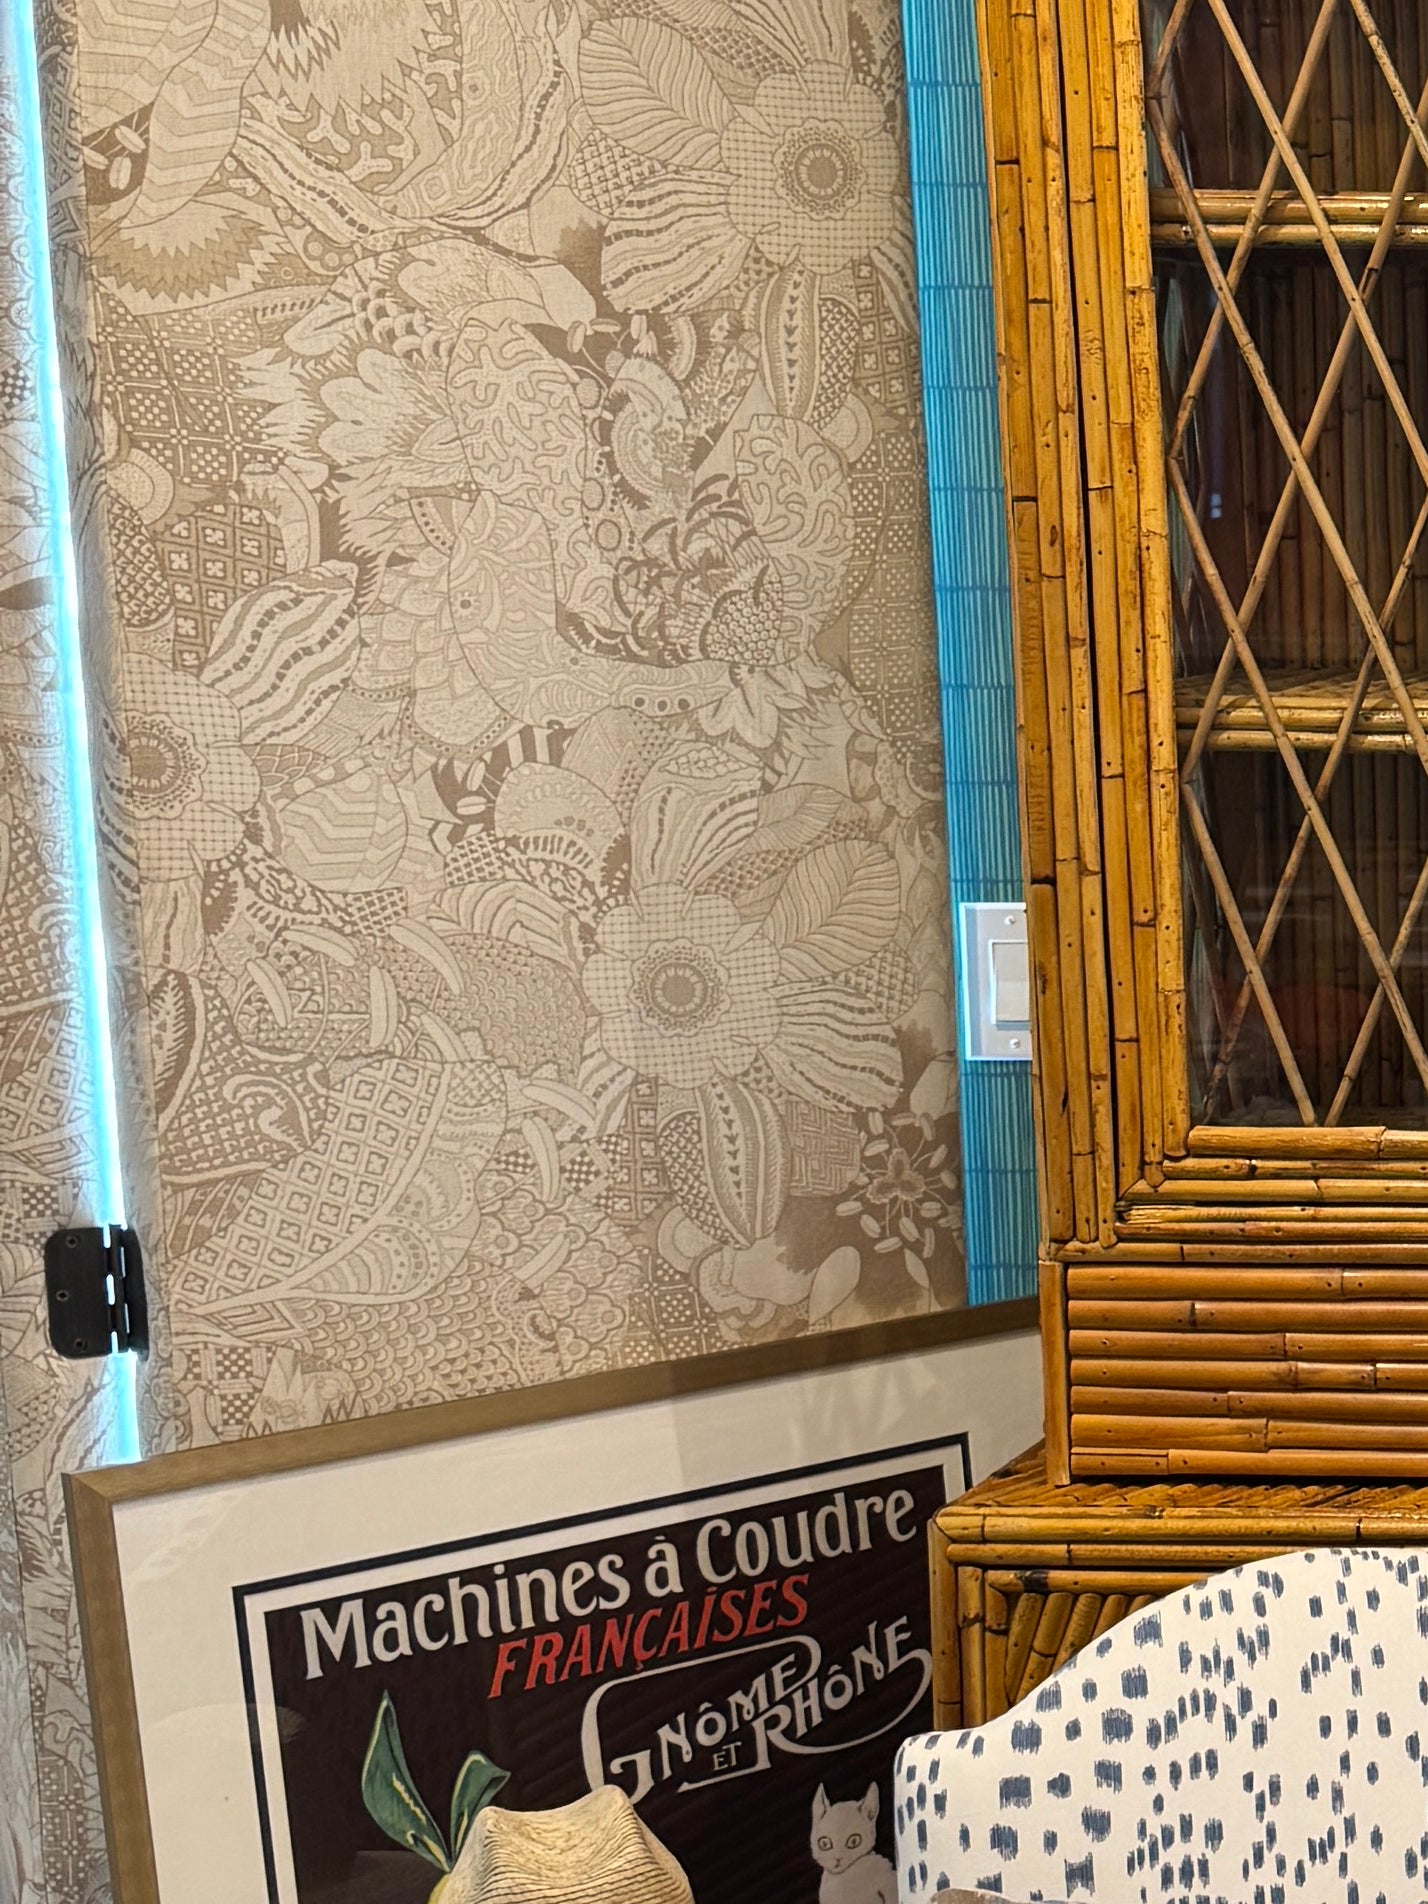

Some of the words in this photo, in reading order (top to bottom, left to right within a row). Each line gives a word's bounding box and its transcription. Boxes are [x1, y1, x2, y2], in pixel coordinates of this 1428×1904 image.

[300, 1554, 631, 1680] Machines
[645, 1534, 684, 1598] à
[696, 1490, 917, 1585] Coudre
[713, 1741, 742, 1772] ET
